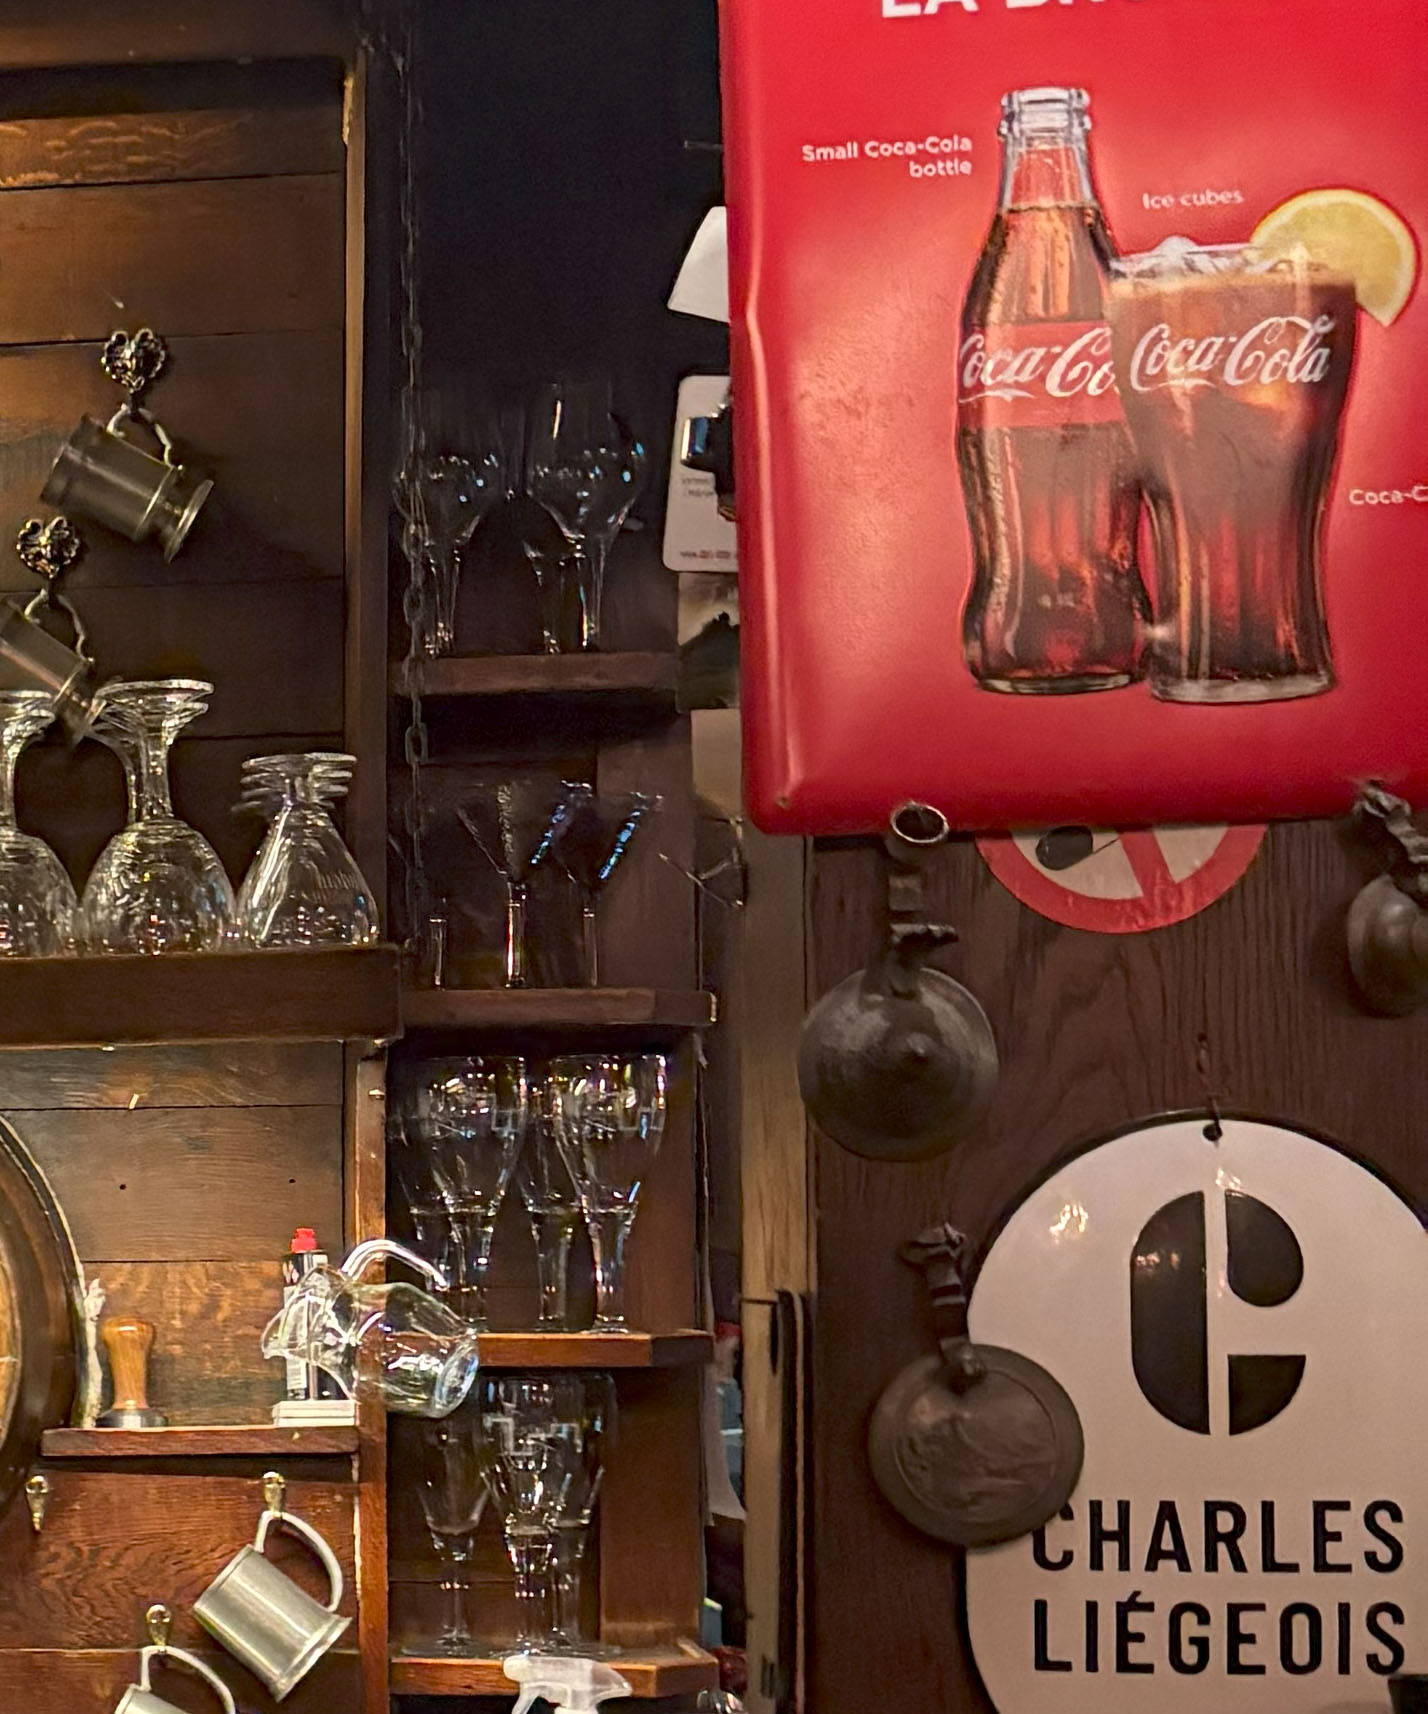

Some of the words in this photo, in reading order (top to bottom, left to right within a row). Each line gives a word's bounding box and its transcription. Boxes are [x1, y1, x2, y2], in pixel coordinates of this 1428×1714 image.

[801, 141, 859, 162] Small
[864, 134, 973, 158] Coca-Cola
[909, 159, 973, 178] bottle
[1142, 193, 1174, 210] Ice
[1180, 188, 1244, 208] cubes
[958, 326, 1118, 403] Coca-Co
[1130, 313, 1337, 392] Coca-Cola
[1349, 485, 1428, 505] Coca-C
[1032, 1499, 1404, 1574] CHARLES
[1033, 1590, 1406, 1676] LIÉGEOIS
